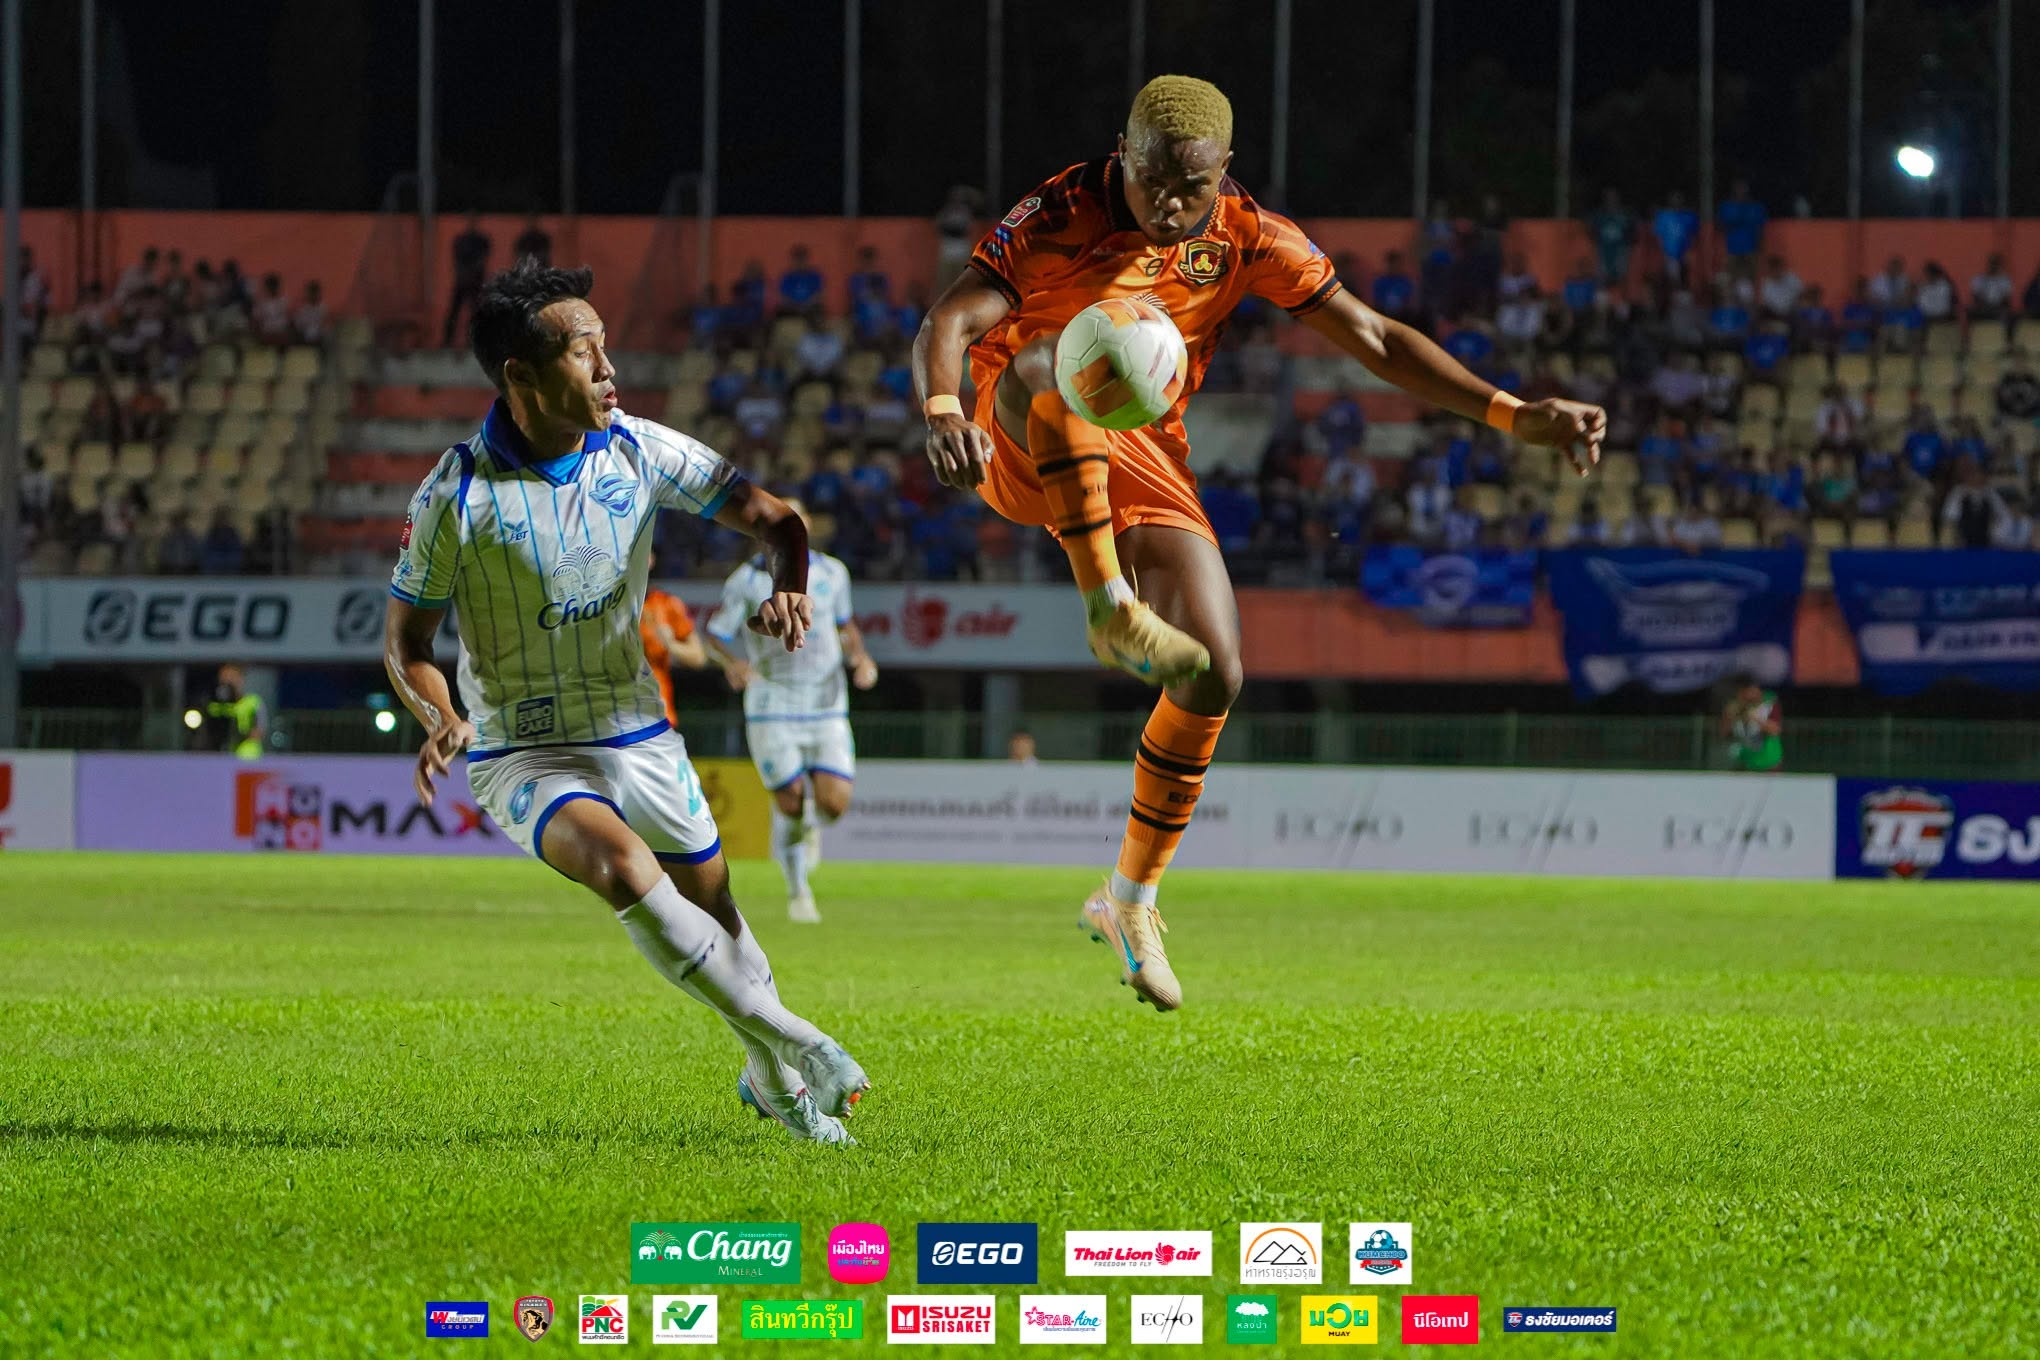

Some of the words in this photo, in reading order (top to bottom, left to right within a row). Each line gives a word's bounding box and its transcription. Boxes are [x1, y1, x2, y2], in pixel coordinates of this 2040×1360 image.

[142, 594, 291, 642] EGO
[537, 582, 627, 631] Chang
[331, 800, 496, 838] MAX
